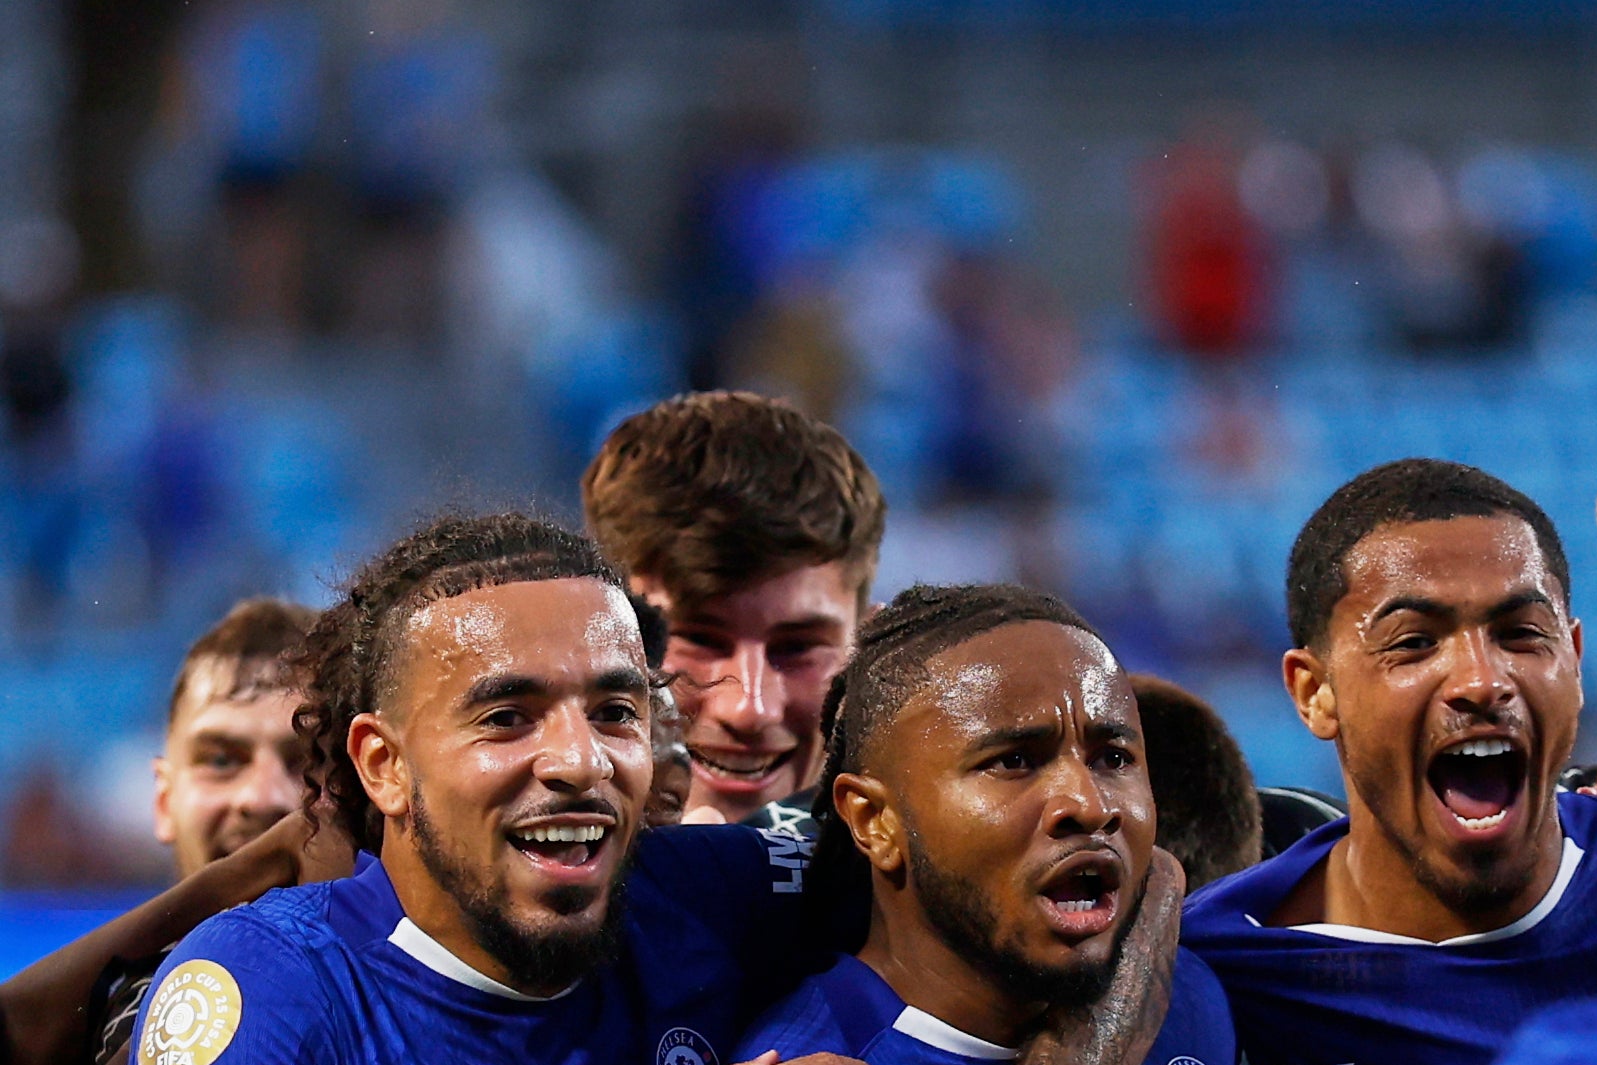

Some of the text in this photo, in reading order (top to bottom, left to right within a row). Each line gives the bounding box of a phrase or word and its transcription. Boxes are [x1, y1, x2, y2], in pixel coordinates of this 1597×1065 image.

[195, 972, 222, 992] CUP
[152, 973, 193, 1017] WORLD
[215, 995, 229, 1014] 25
[200, 1018, 226, 1049] USA
